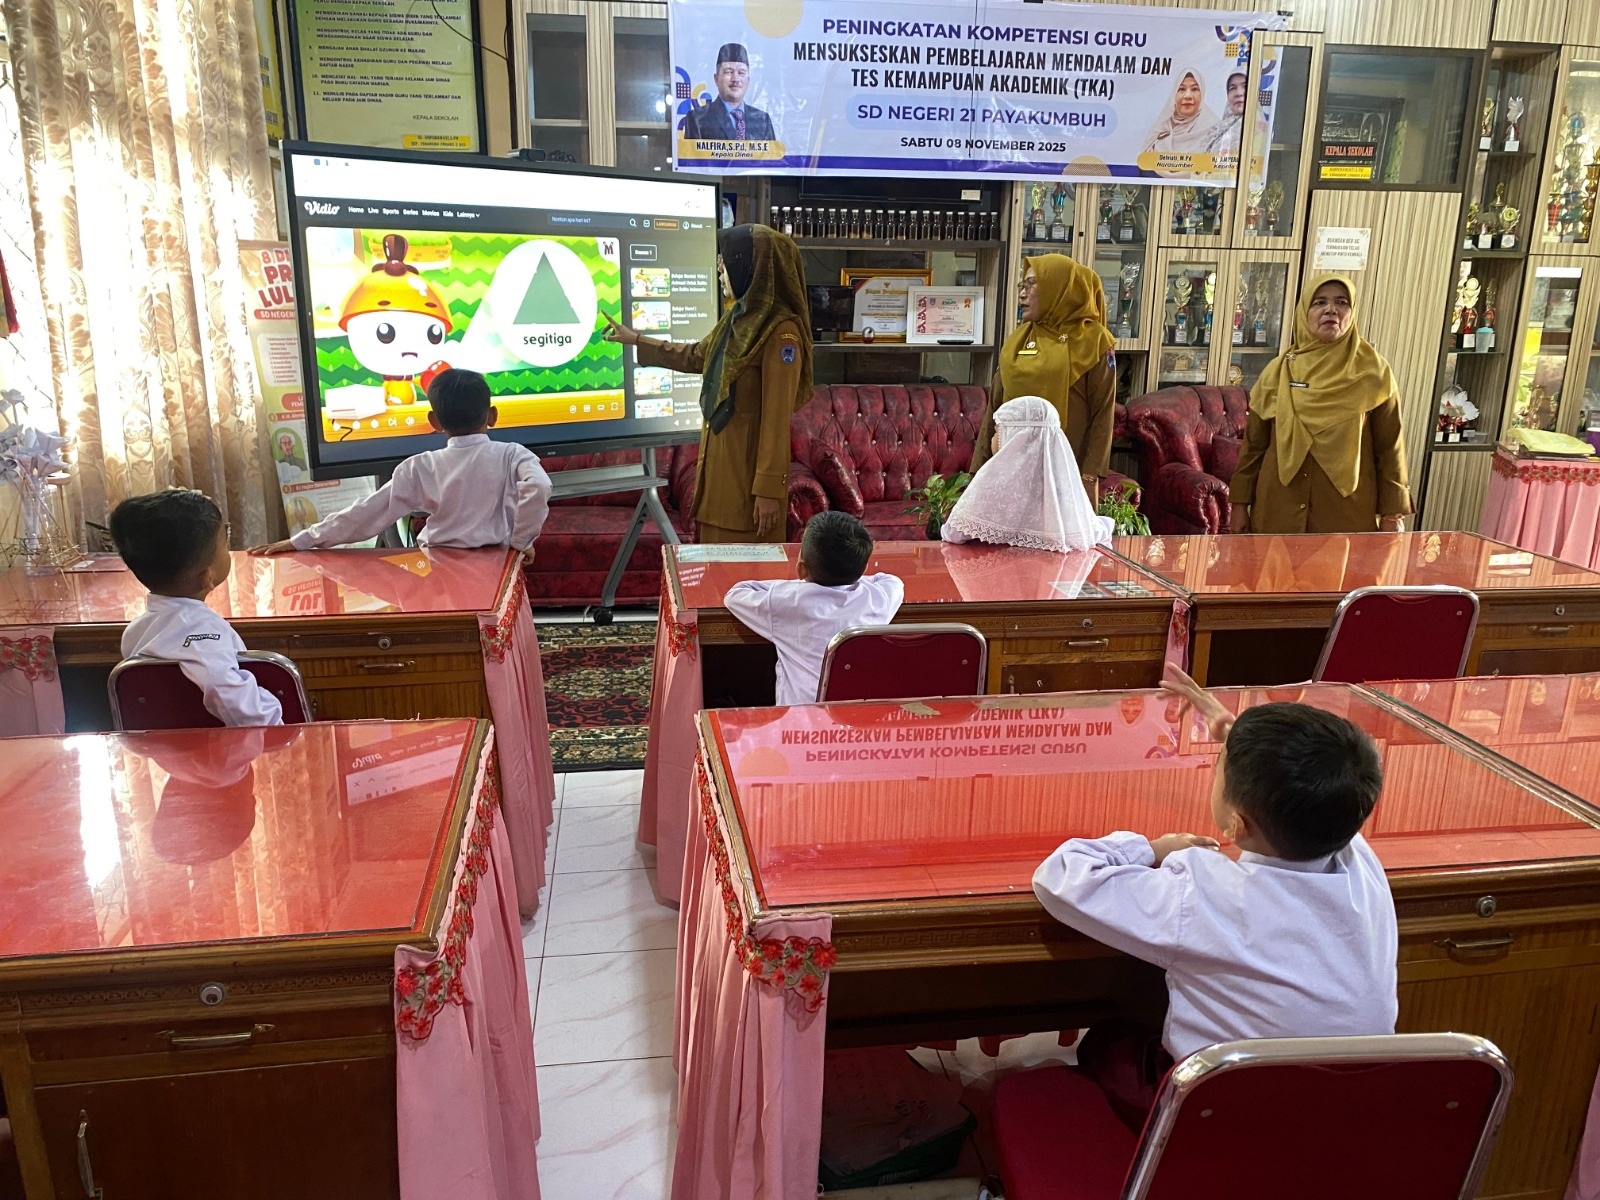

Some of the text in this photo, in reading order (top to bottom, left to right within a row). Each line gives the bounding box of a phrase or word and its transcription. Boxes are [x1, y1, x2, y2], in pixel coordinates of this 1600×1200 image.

[822, 18, 1147, 48] PENINGKATAN KOMPETENSI GURU
[794, 42, 1172, 76] MENSUKSESKAN PEMBELAJARAN MENDALAM DAN
[852, 68, 1114, 100] TES KEMAMPUAN AKADEMIK (TKA)
[858, 104, 1106, 127] SD NEGERI 21 PAYAKUMBUH
[900, 137, 1066, 152] SABTU 08 NOVEMBER 2025
[1324, 146, 1374, 157] KEPALA SEKOLAH
[304, 201, 340, 216] Vidio
[348, 206, 364, 214] Home
[382, 207, 400, 215] Sports
[261, 251, 271, 264] 8
[260, 310, 270, 318] SD
[524, 332, 572, 347] segitiga
